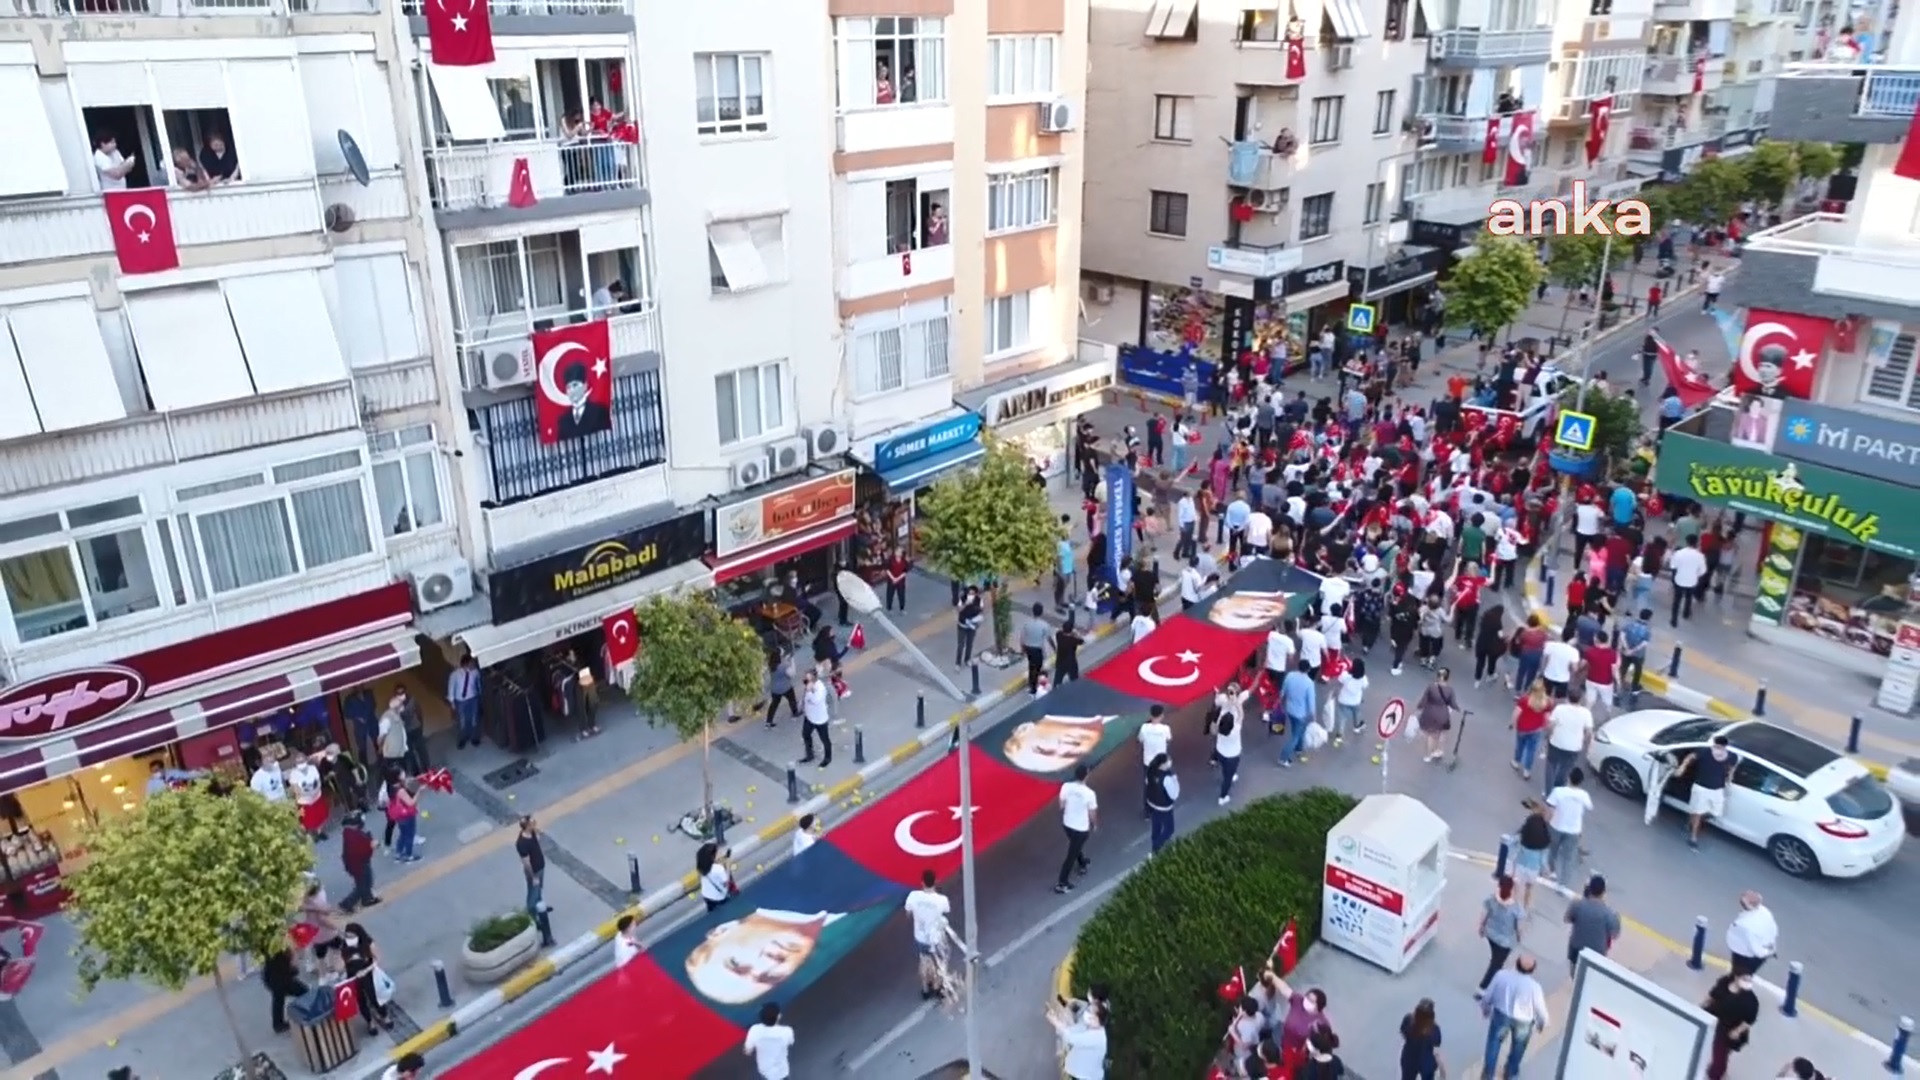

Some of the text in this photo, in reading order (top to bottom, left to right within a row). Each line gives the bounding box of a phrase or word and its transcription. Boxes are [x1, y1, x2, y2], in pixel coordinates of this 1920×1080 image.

[894, 424, 965, 458] SÜMER MARKET
[1817, 423, 1849, 450] İYİ
[1690, 473, 1879, 543] tavukçuluk
[554, 543, 658, 590] Malabadi
